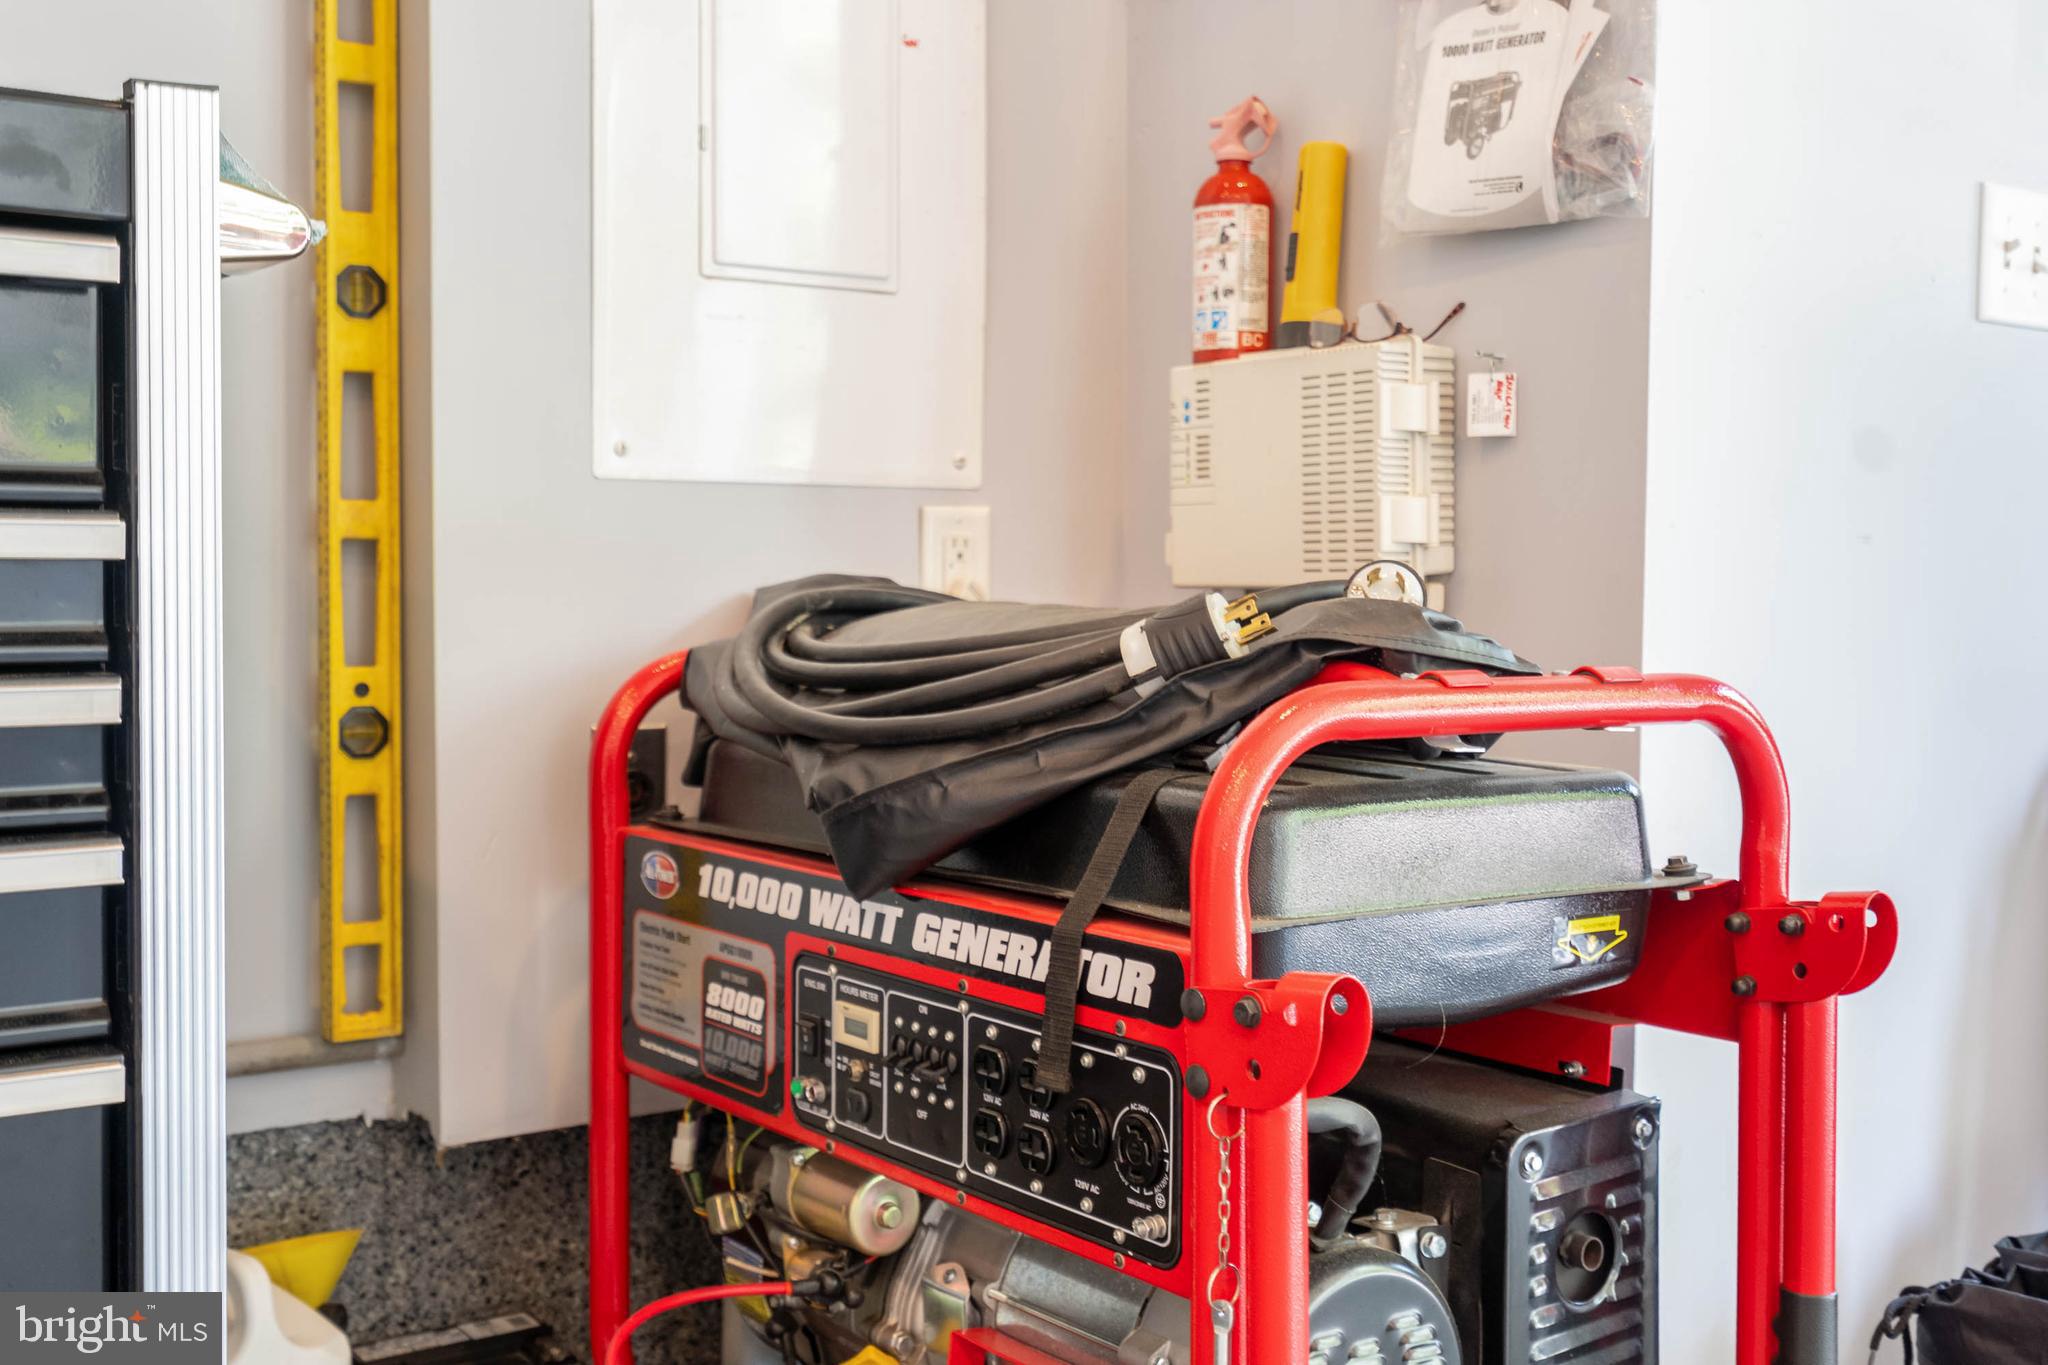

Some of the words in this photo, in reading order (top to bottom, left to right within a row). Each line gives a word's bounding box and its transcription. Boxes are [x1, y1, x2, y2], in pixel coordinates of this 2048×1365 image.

[1442, 43, 1470, 58] 10000
[1472, 39, 1494, 54] WATT
[1496, 31, 1546, 50] GENERATOR
[1241, 332, 1264, 347] BC
[698, 863, 803, 921] 10,000
[809, 888, 904, 945] WATT
[706, 982, 766, 1022] 8000
[840, 983, 859, 997] HOURS
[859, 989, 879, 1003] METER
[918, 1004, 928, 1015] ON
[733, 1016, 763, 1036] WATTS
[993, 1097, 1002, 1107] AC
[916, 1109, 928, 1120] OFF
[1039, 1112, 1049, 1123] AC
[1074, 1178, 1087, 1192] 120V
[1087, 1183, 1100, 1196] AC
